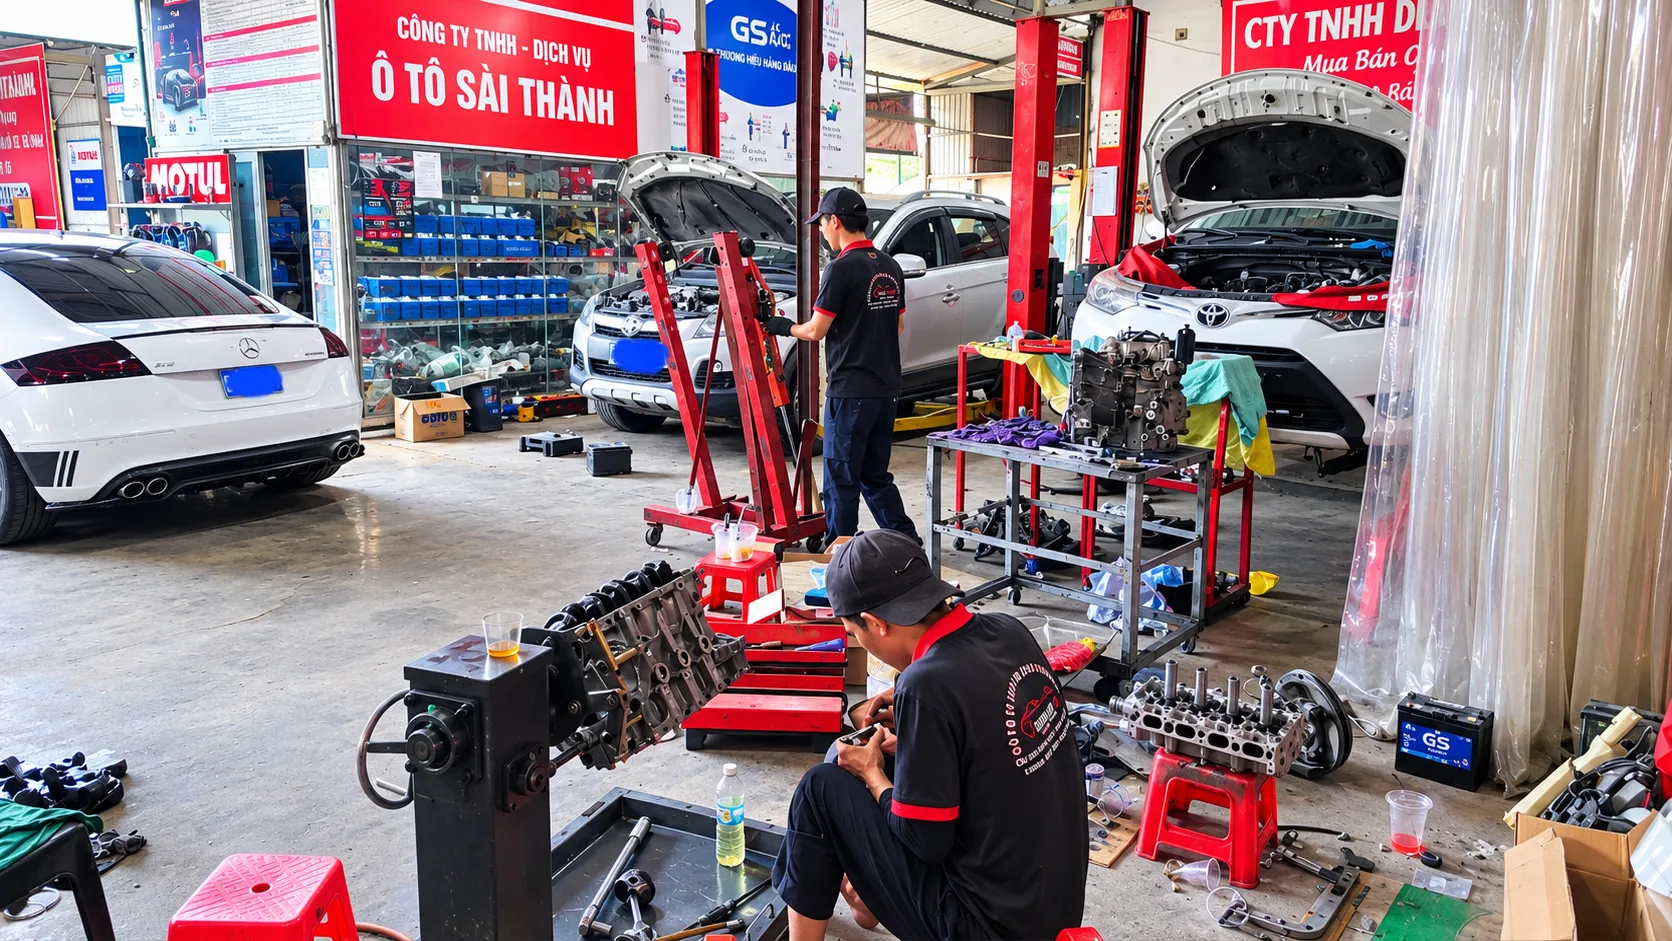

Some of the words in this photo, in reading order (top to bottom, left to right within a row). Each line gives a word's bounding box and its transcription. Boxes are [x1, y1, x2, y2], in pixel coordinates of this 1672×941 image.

[397, 13, 446, 45] CÔNG
[449, 24, 470, 48] TY
[474, 28, 517, 56] TNHH
[533, 38, 569, 66] DỊCH
[572, 45, 592, 72] VỤ
[730, 15, 768, 47] GS
[1244, 13, 1298, 49] CTY
[1304, 2, 1385, 43] TNHH
[1303, 54, 1349, 74] Mua
[1355, 47, 1398, 71] Bán
[371, 50, 395, 102] Ô
[404, 56, 446, 107] TÔ
[456, 63, 509, 114] SÀI
[518, 75, 614, 126] THÀNH
[151, 162, 227, 196] MOTUL
[1422, 732, 1450, 751] GS
